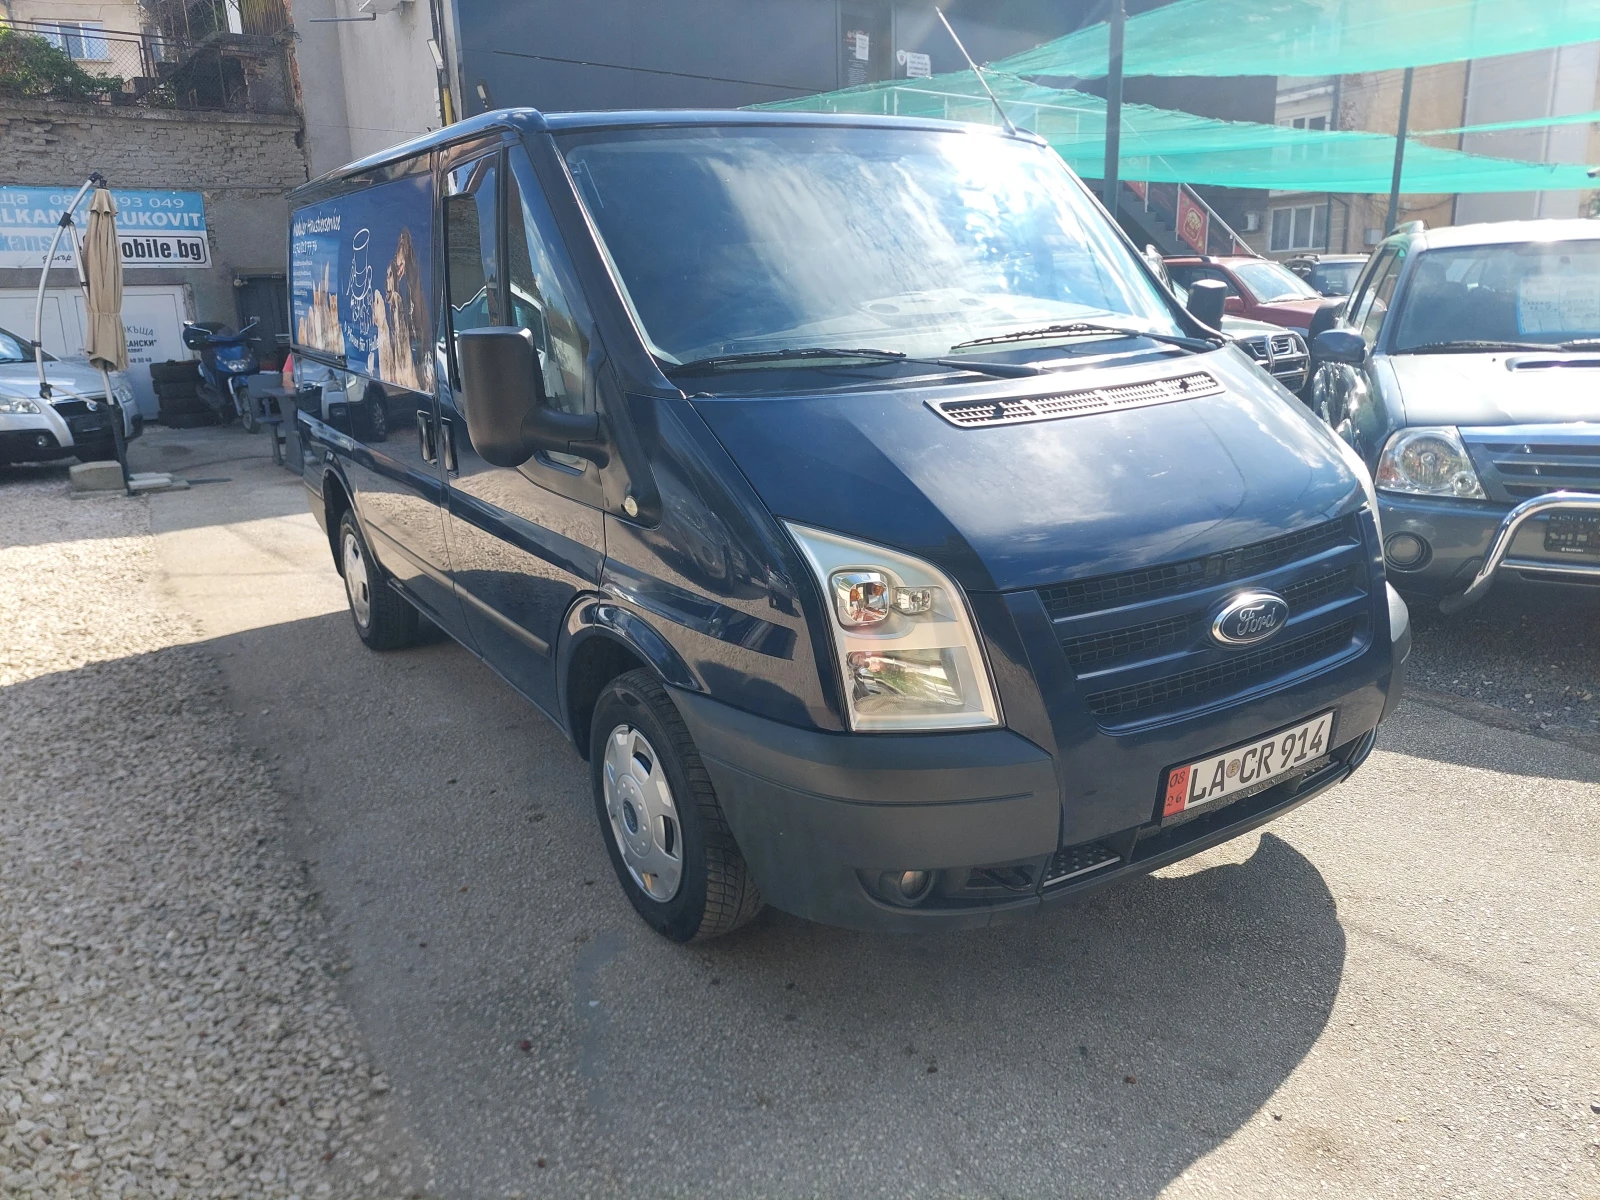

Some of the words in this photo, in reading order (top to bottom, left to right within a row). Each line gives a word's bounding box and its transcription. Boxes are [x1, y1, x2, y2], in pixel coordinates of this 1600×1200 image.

[149, 198, 184, 209] 049
[121, 240, 201, 261] obile.bg
[1236, 604, 1277, 636] Ford
[1187, 759, 1226, 804] LA
[1239, 741, 1276, 784] CR
[1280, 719, 1326, 770] 914
[1169, 771, 1185, 789] 08
